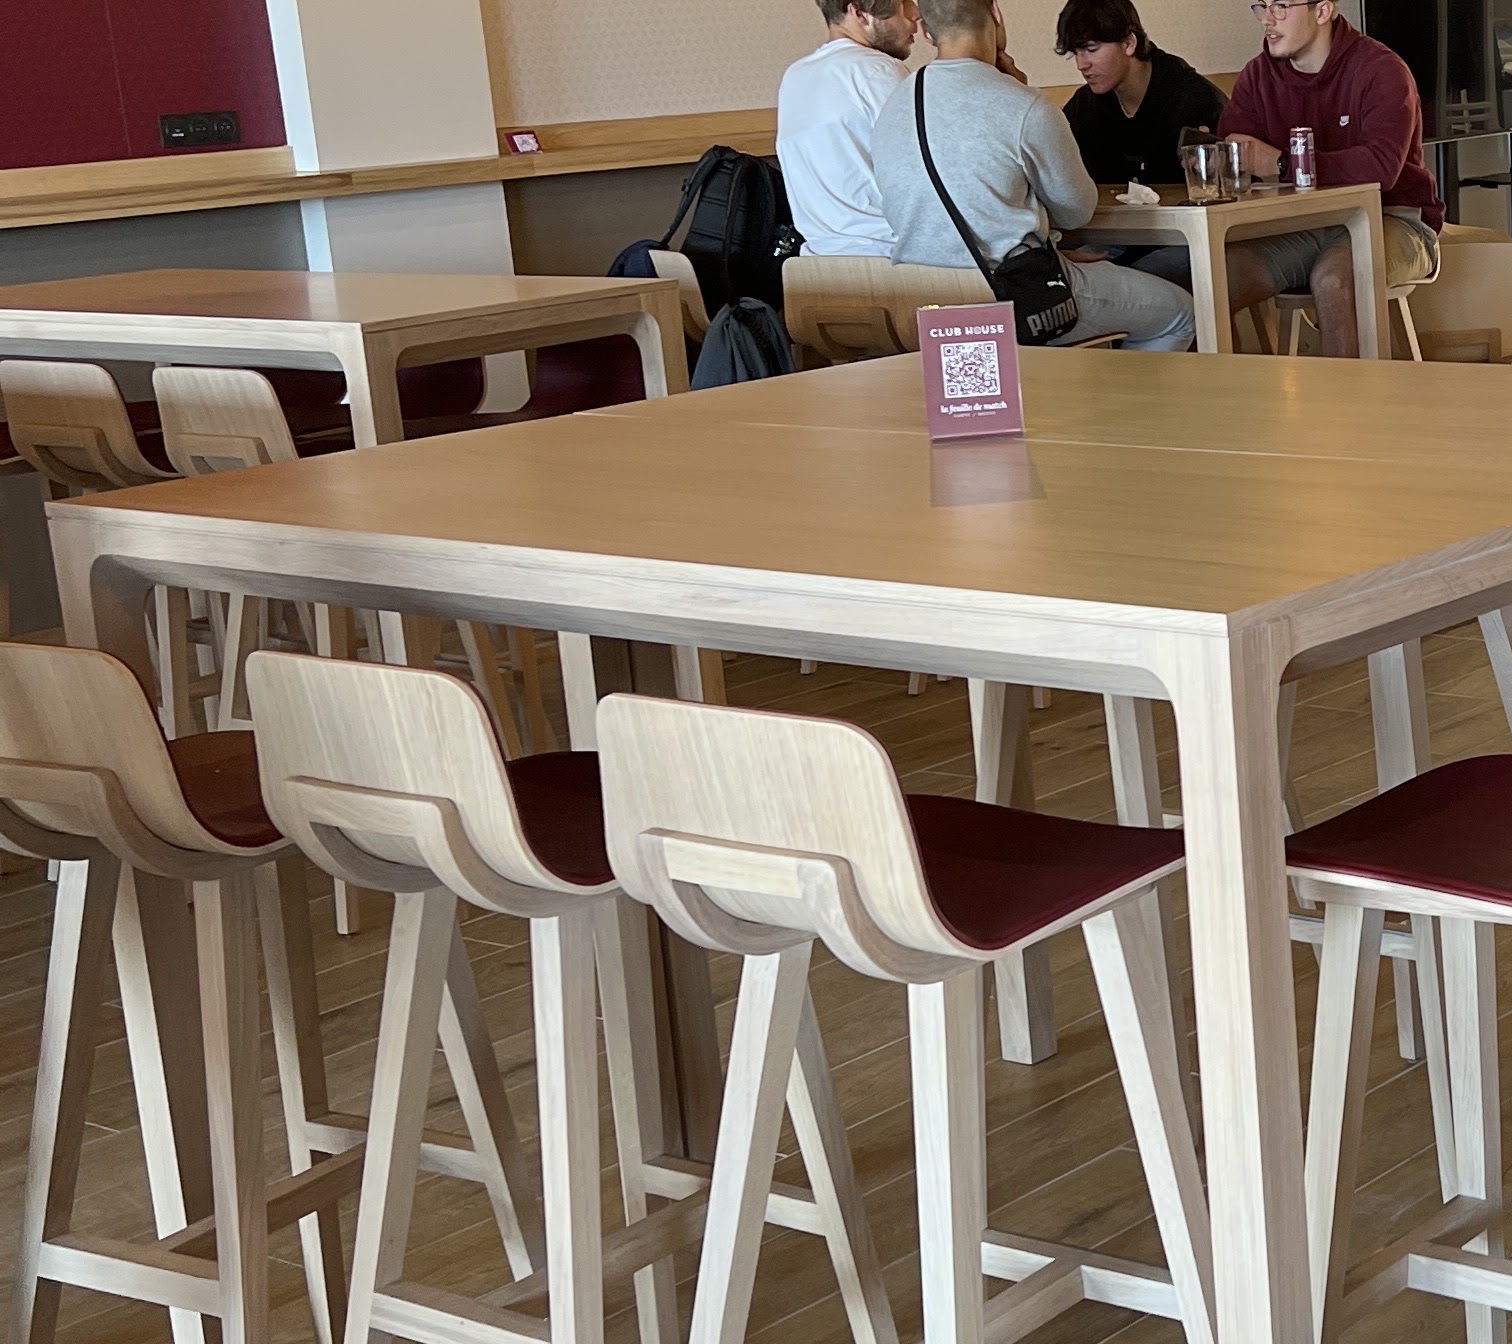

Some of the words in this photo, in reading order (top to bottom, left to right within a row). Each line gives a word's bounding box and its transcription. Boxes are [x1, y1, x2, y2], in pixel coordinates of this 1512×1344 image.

[1026, 297, 1078, 337] PUMA
[929, 327, 962, 338] CLUB
[964, 324, 1005, 336] HOUSE
